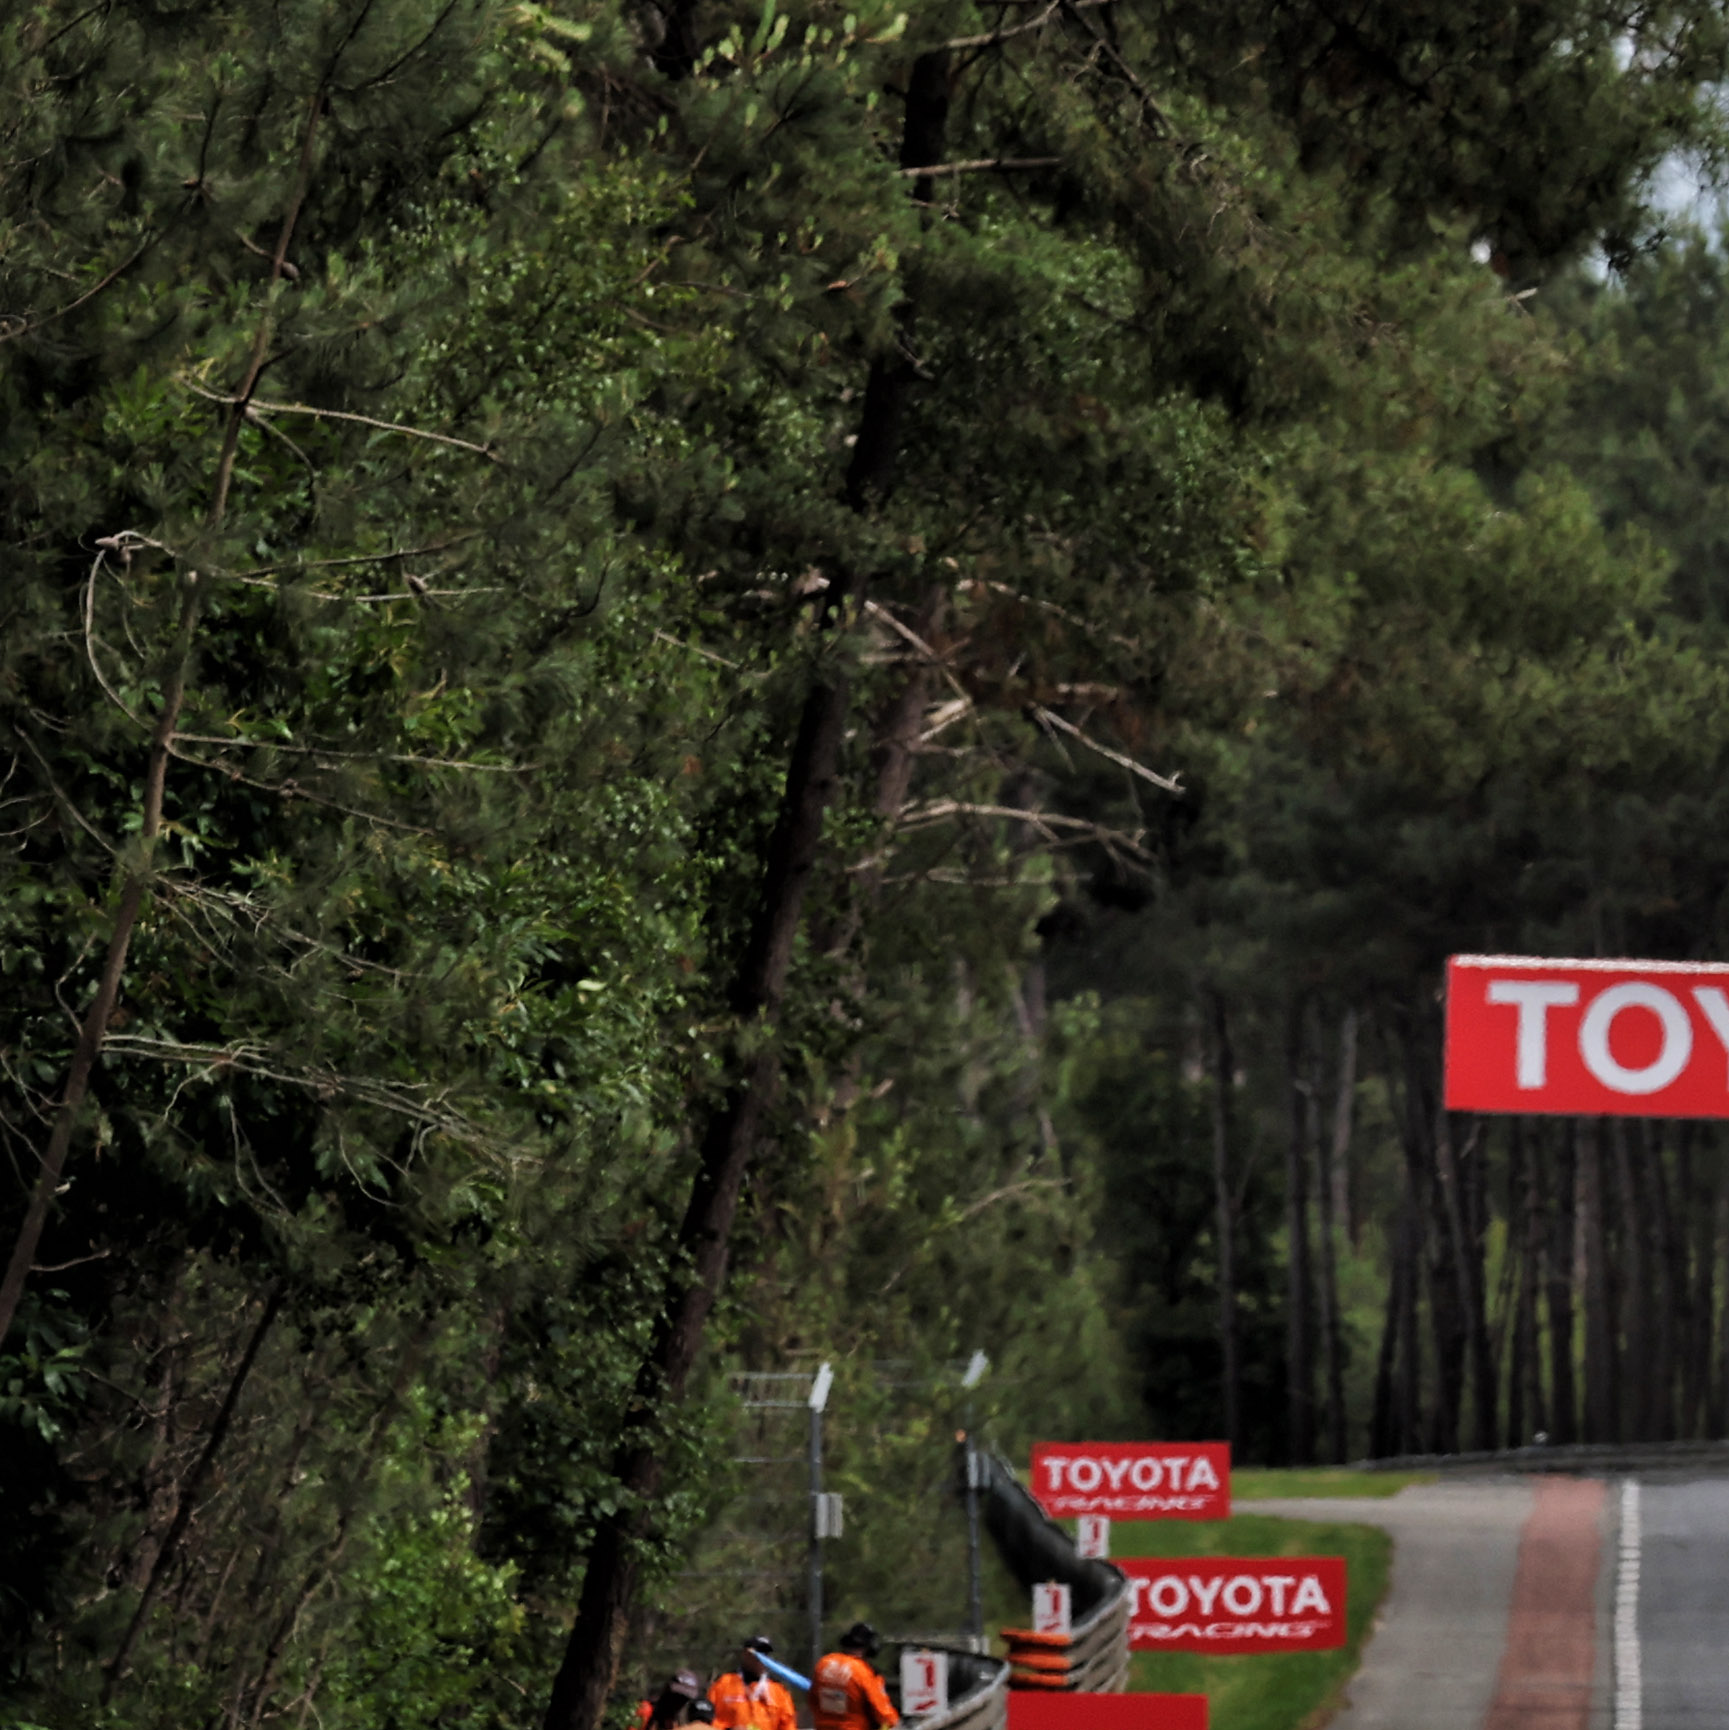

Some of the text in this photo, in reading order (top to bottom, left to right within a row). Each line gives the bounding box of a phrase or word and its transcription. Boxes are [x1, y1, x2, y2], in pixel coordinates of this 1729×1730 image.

[1042, 1456, 1219, 1491] TOYOTA
[1128, 1575, 1331, 1617] TOYOTA
[1129, 1622, 1332, 1639] RACING
